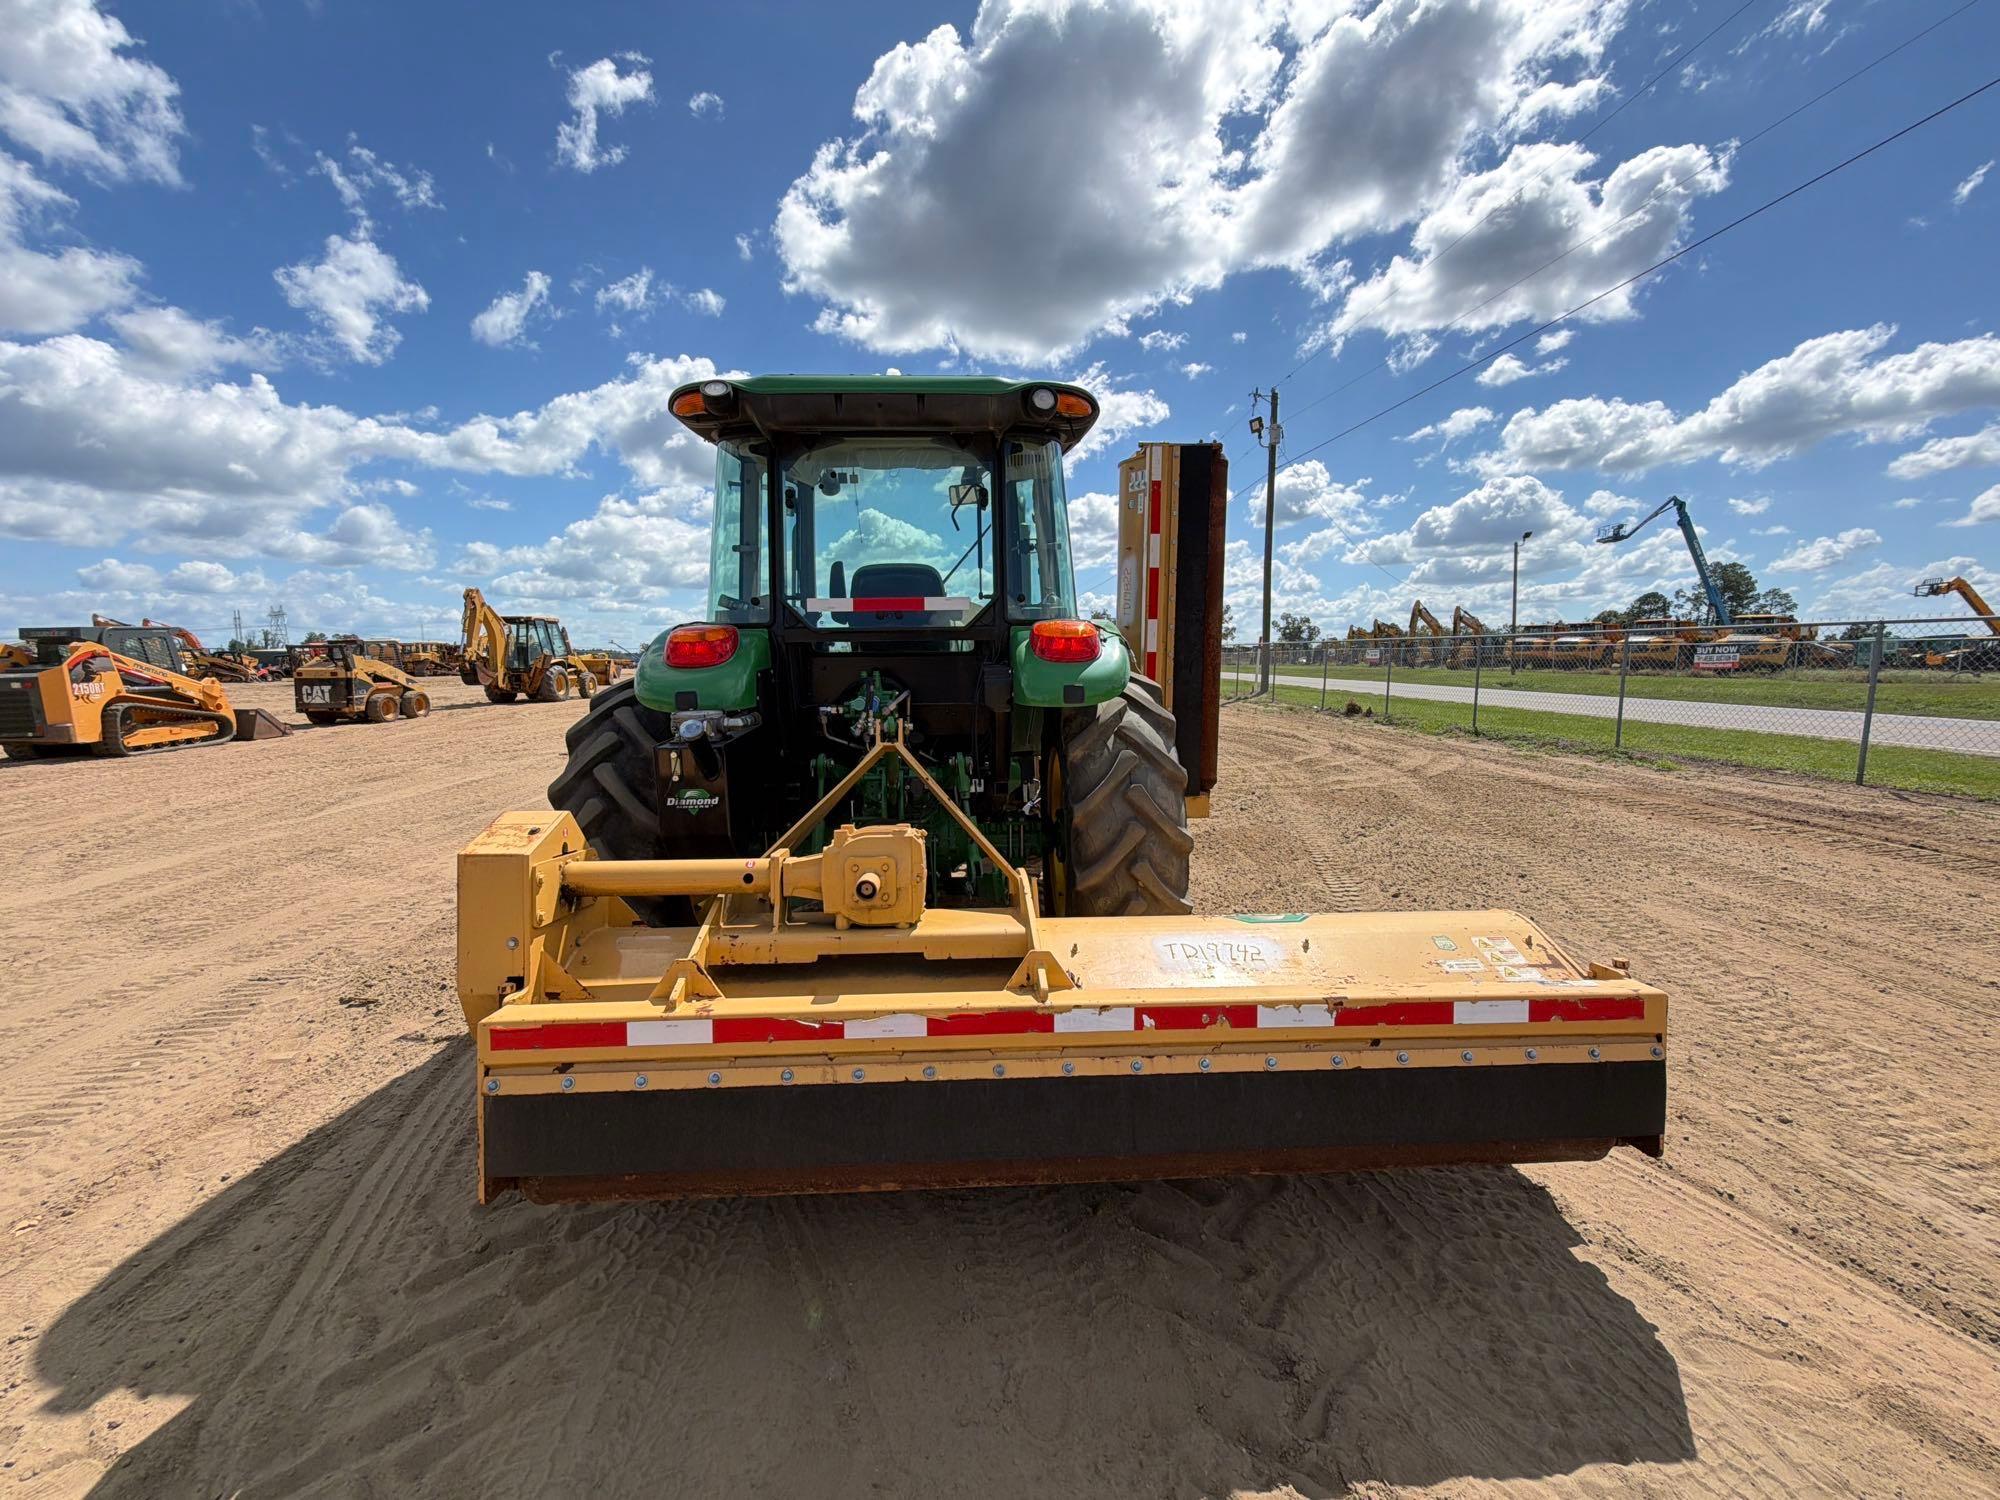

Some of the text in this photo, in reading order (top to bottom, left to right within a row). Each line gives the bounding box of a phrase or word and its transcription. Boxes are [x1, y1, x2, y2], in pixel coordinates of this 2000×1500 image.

[1715, 645, 1738, 653] NOW
[72, 682, 105, 695] 2150RT
[302, 685, 332, 704] CAT
[666, 797, 719, 806] Diamond
